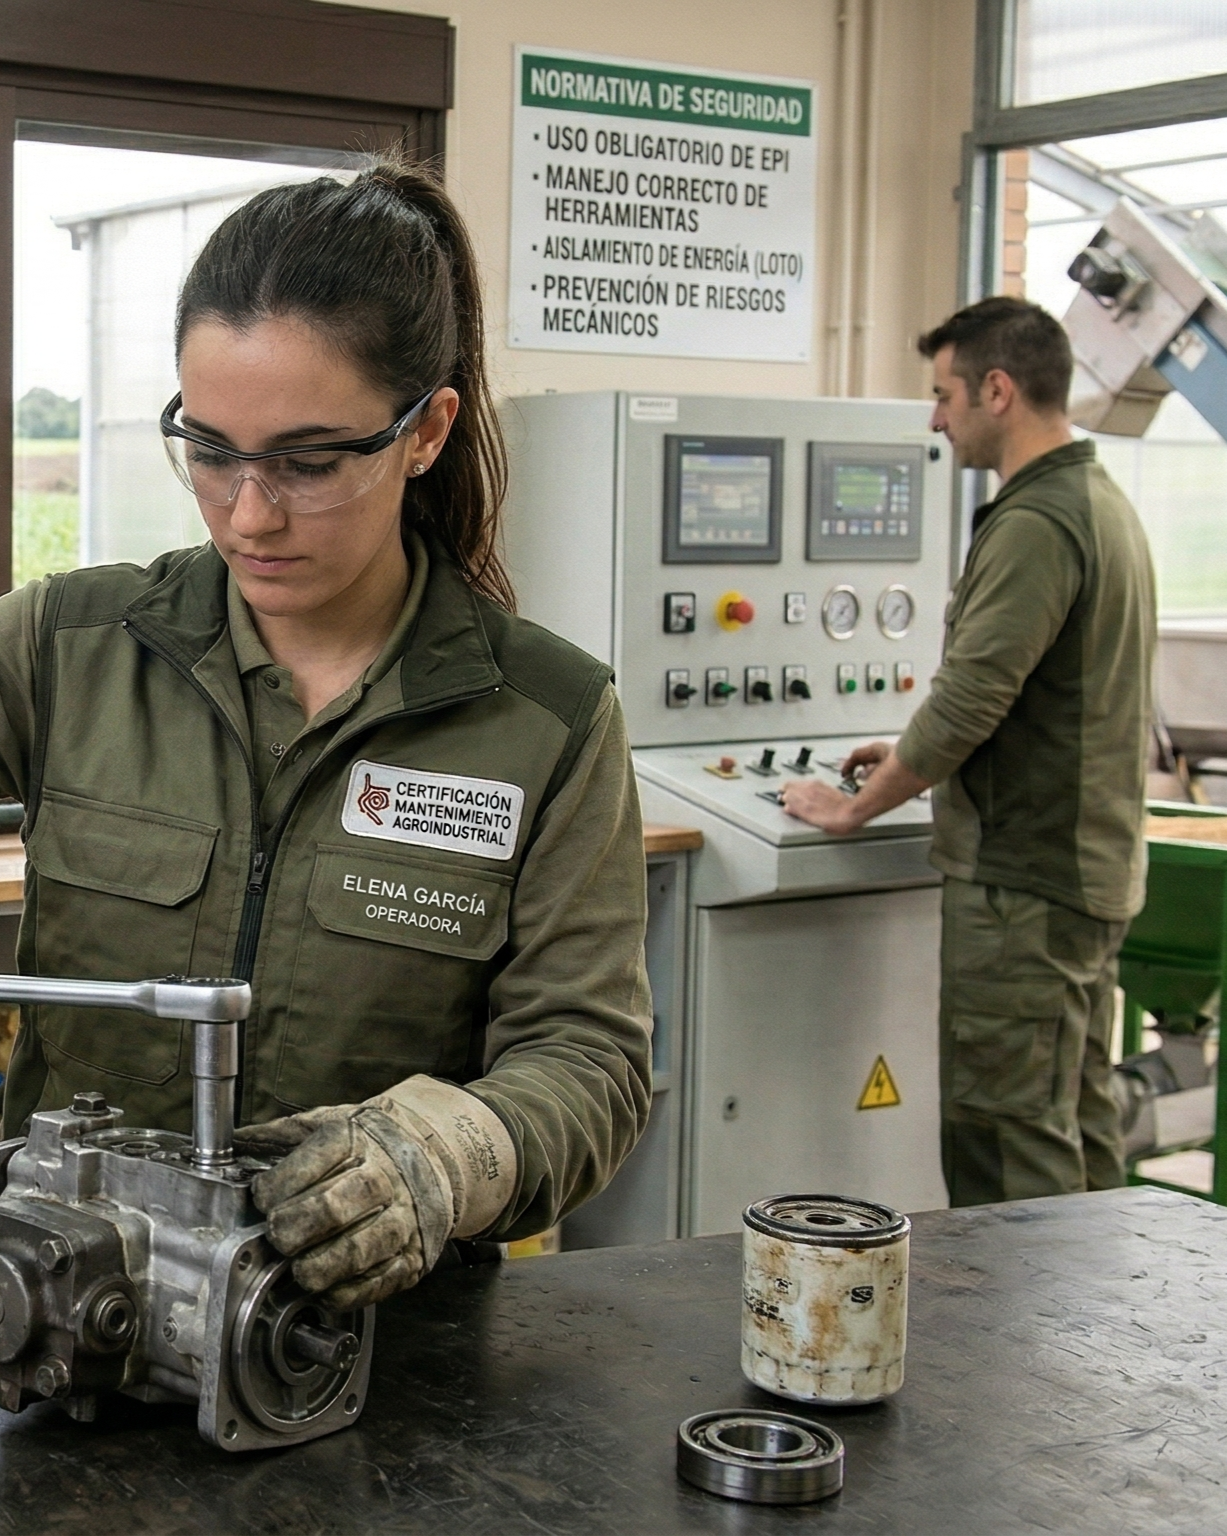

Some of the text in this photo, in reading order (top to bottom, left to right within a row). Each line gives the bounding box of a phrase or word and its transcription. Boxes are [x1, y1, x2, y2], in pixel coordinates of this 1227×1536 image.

[530, 68, 803, 124] NORMATIVA DE SEGURIDAD
[547, 125, 789, 173] USO OBLIGATORIO DE EPI
[546, 165, 768, 208] MANEJO CORRECTO DE
[546, 197, 699, 233] HERRAMIENTAS
[544, 236, 803, 282] AISLAMIENTO DE ENERGÍA (LOTO)
[544, 274, 786, 313] PREVENCIÓN DE RIESGOS
[543, 303, 658, 337] MECÁNICOS
[395, 800, 511, 830] MANTENIMIENTO
[396, 781, 511, 812] CERTIFICACIÓN
[393, 815, 506, 846] AGROINDUSTRIAL
[343, 874, 486, 916] ELENA GARCÍA
[365, 904, 461, 935] OPERADORA
